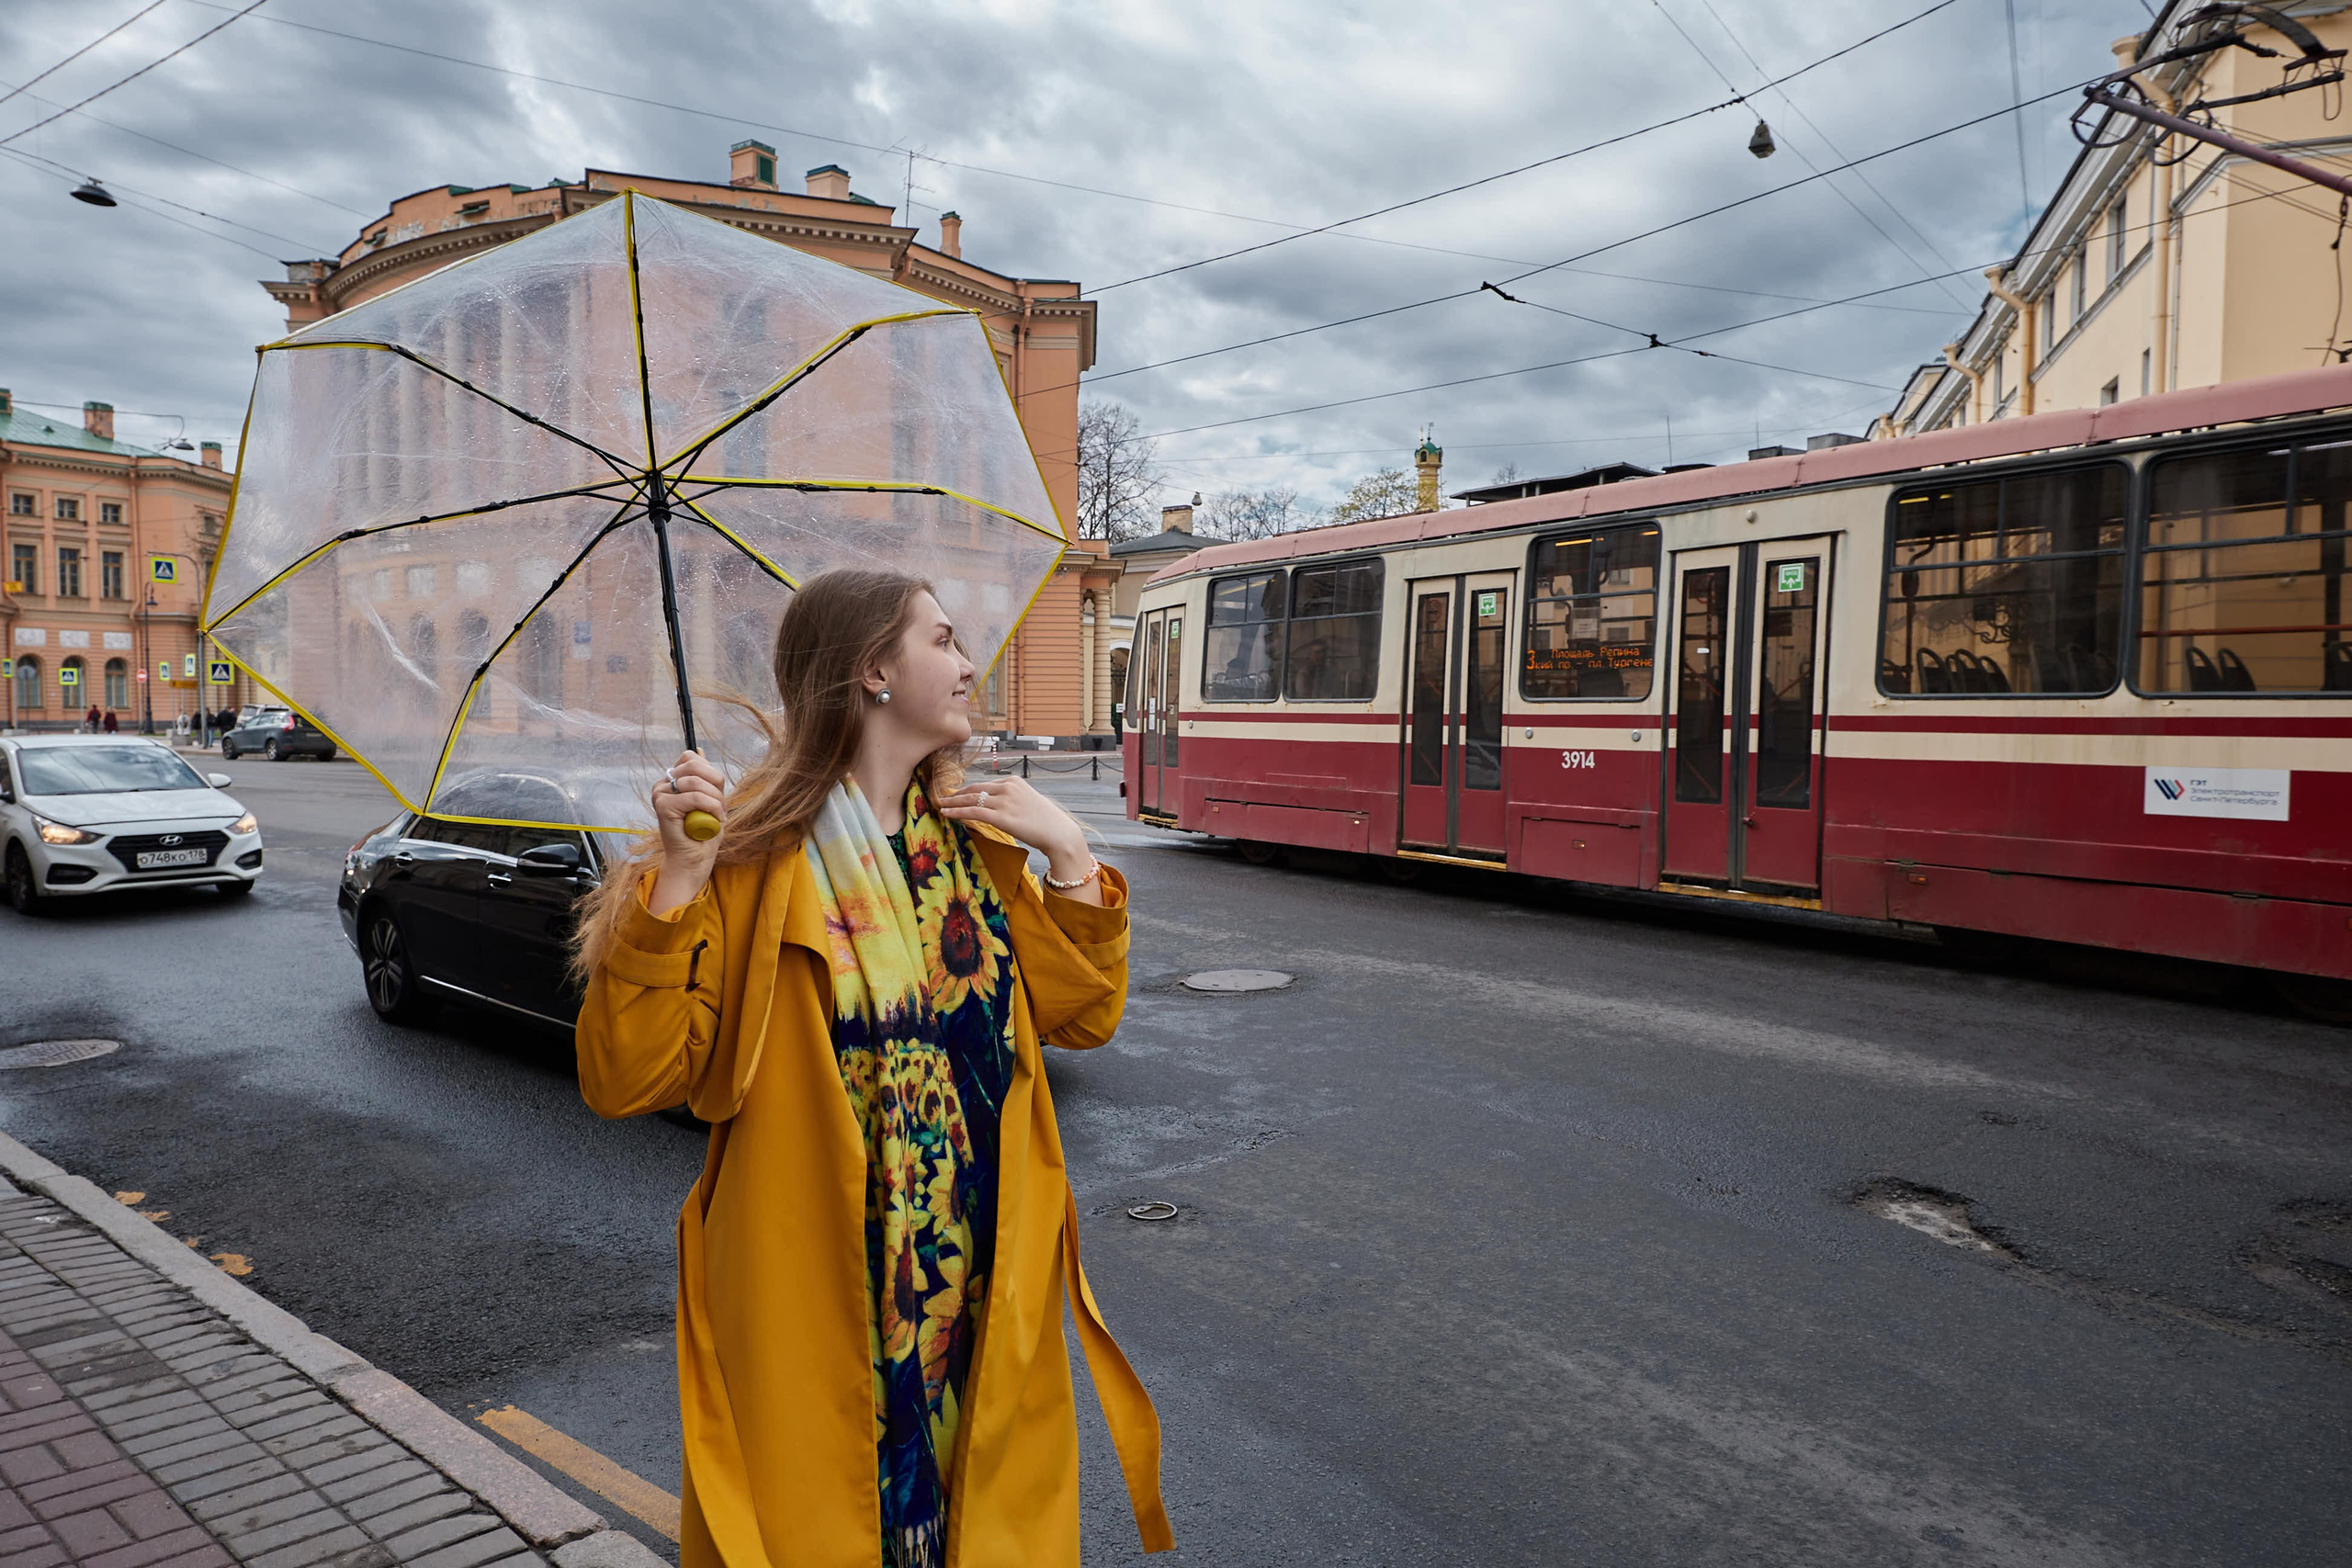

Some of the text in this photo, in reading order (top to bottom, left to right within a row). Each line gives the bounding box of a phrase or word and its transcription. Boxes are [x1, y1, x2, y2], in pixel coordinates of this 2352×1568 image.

[1526, 649, 1535, 670] 3
[1552, 646, 1640, 659] Площадь Репина
[1562, 750, 1595, 769] 3914
